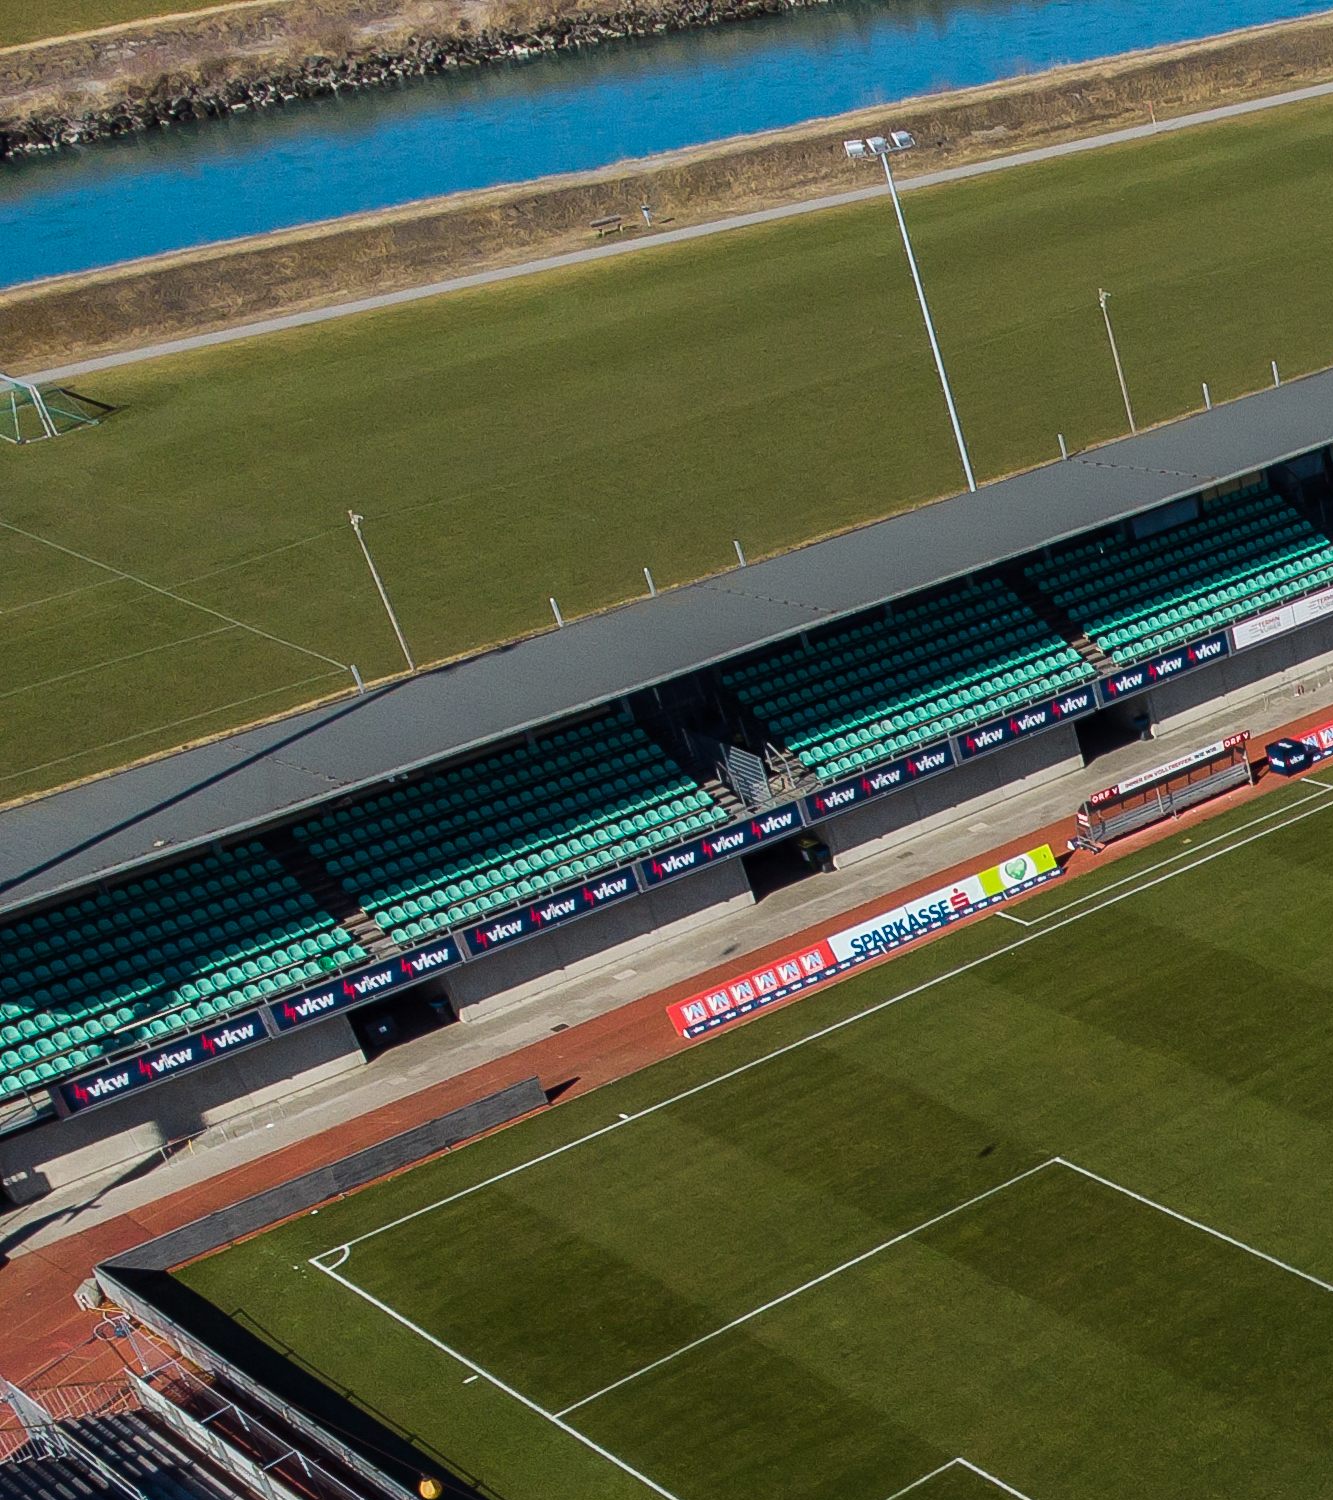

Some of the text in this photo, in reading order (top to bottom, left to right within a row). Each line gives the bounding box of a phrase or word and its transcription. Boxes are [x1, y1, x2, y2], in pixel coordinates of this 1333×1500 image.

[1116, 641, 1221, 692] vkw vkw vkw
[974, 694, 1088, 749] vkw vkw vkw
[1224, 734, 1242, 748] ORF
[824, 752, 945, 808] vkw vkw vkw
[1092, 791, 1110, 804] ORF
[661, 812, 792, 873] vkw vkw vkw
[486, 878, 627, 943] vkw vkw vkw
[850, 899, 950, 956] SPARKASSE
[295, 948, 449, 1016] vkw vkw vkw
[86, 1024, 254, 1097] vkw vkw vkw
